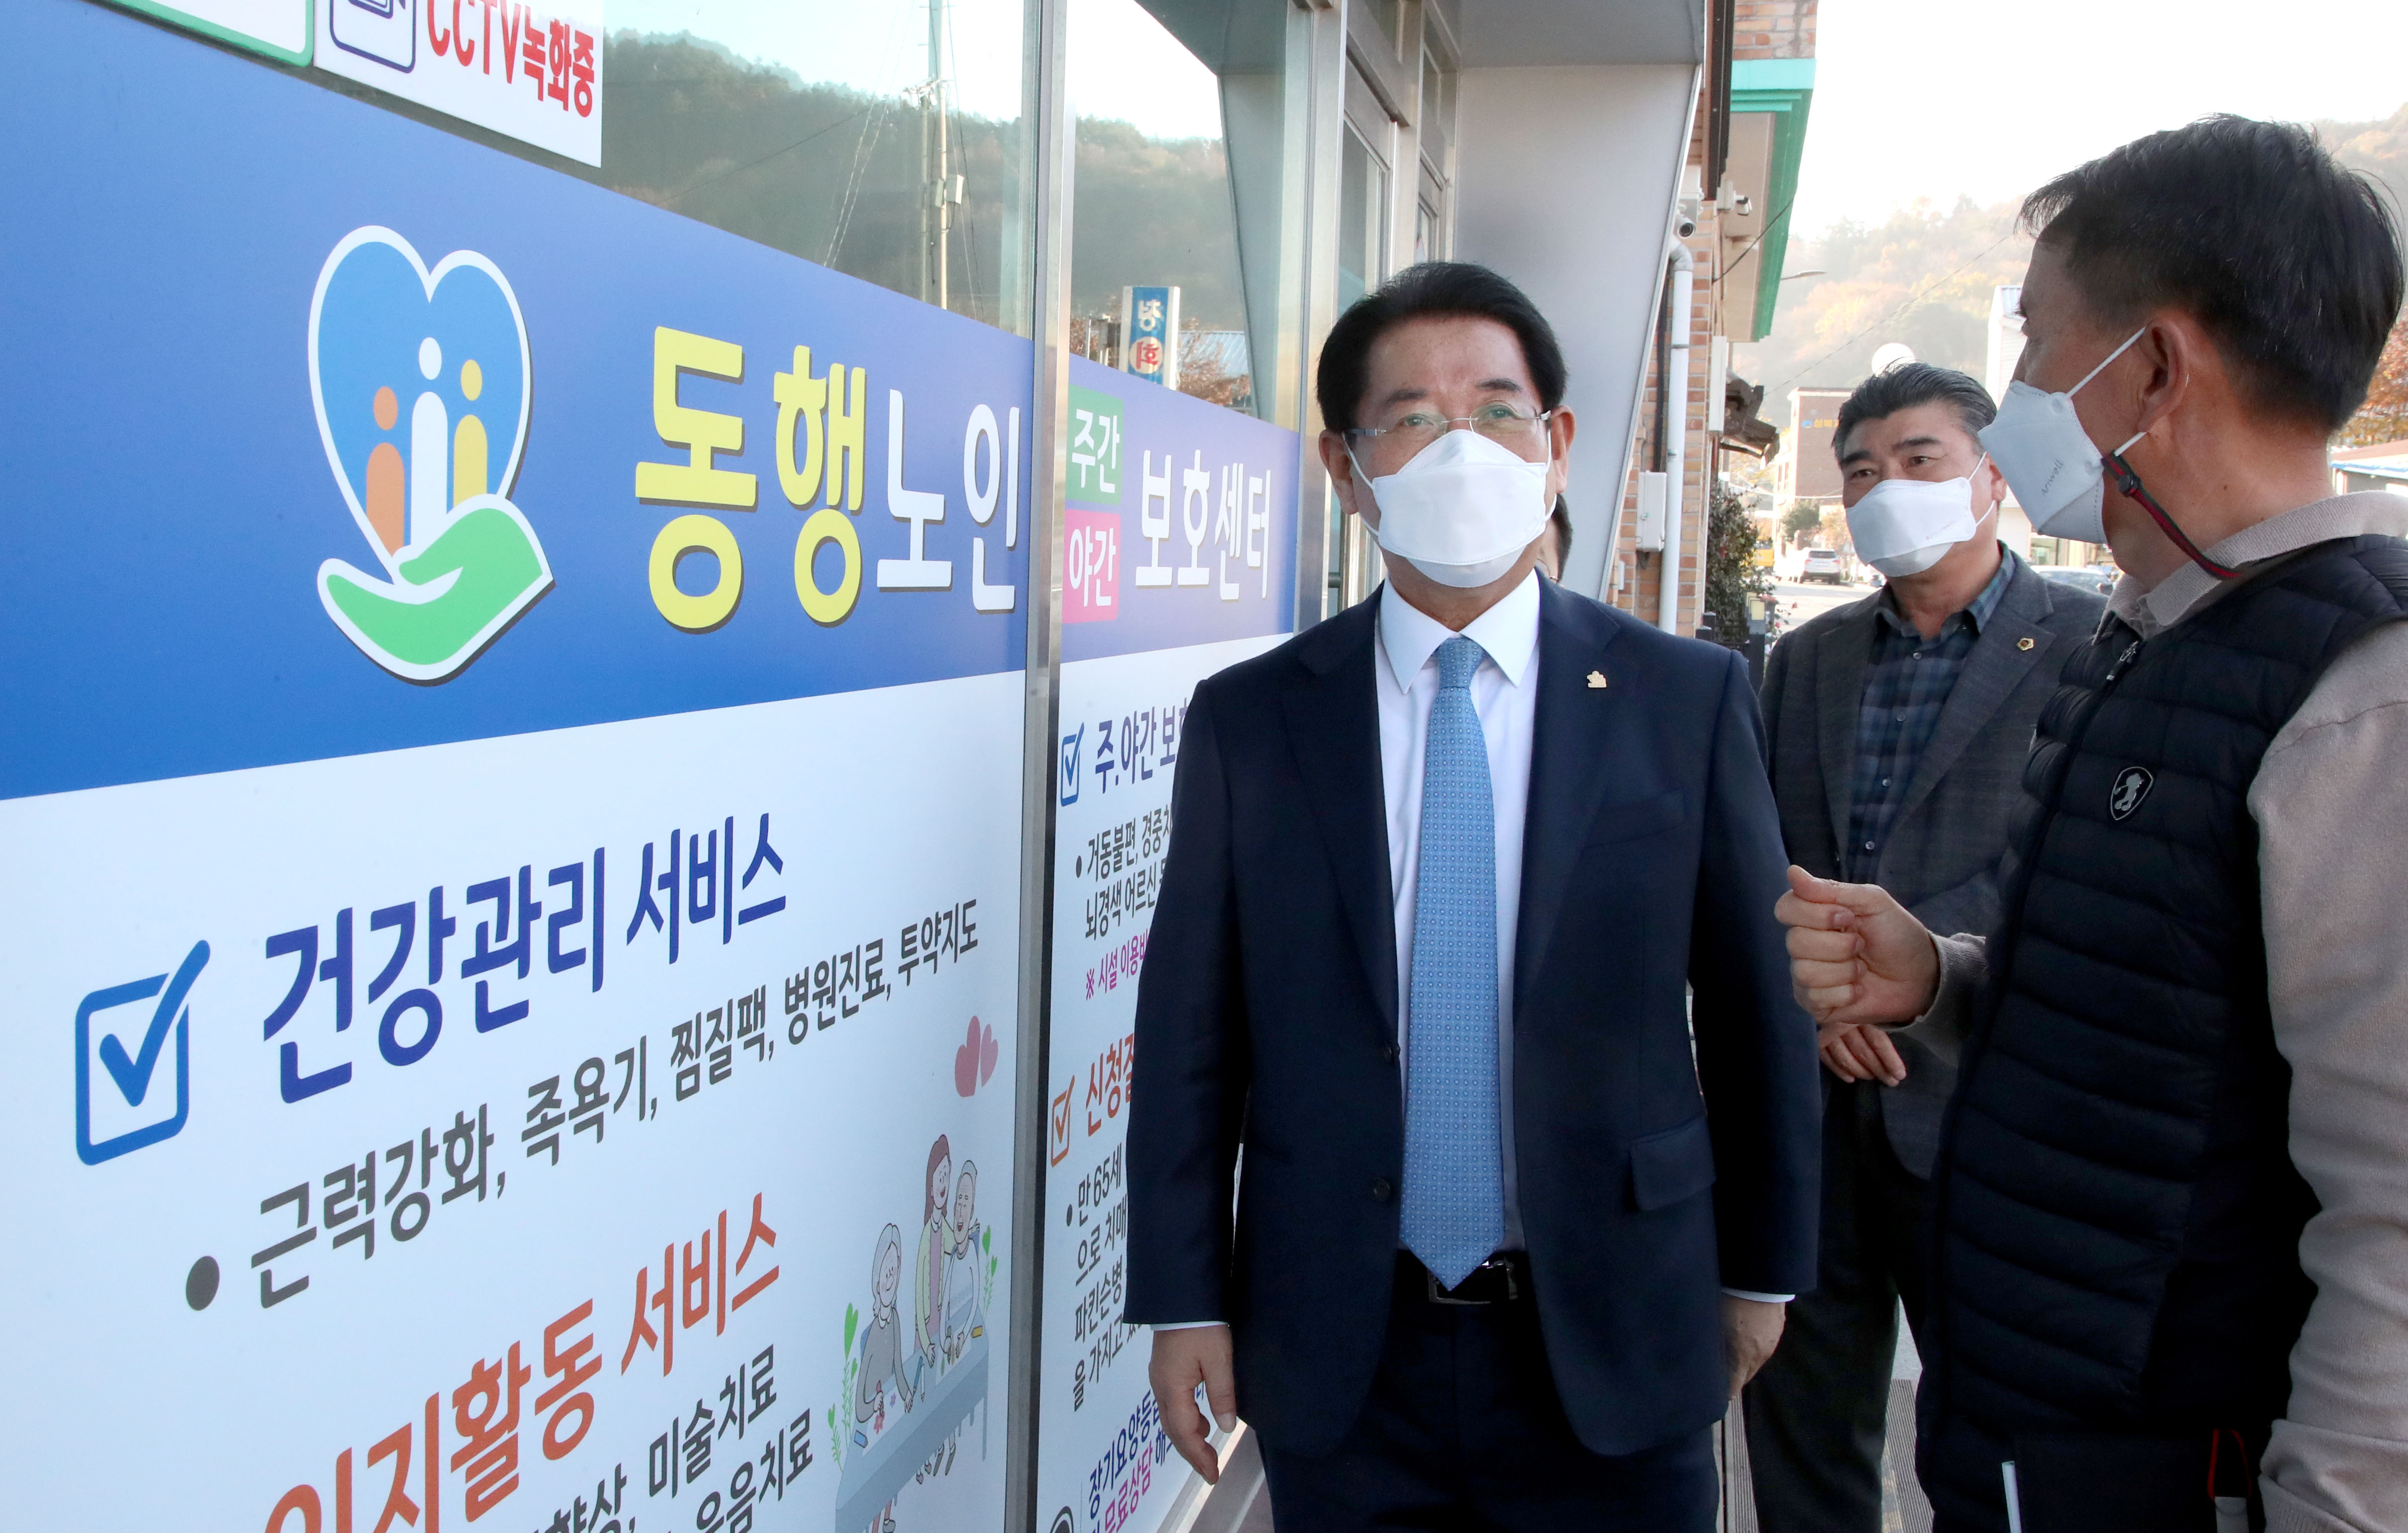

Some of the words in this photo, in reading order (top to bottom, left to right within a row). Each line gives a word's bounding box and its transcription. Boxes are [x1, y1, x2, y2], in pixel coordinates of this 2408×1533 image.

[427, 0, 594, 118] CCTV녹화중
[635, 326, 1020, 629] 동행노인
[1072, 408, 1121, 493] 주간
[1069, 526, 1116, 607] 야간
[1135, 449, 1271, 601] 보호센터
[1095, 706, 1157, 794] 주.야간
[1087, 817, 1138, 882] 거동불편,
[1085, 879, 1122, 941] 뇌경색
[1125, 861, 1157, 918] 어르신
[263, 846, 606, 1104] 건강관리
[627, 813, 787, 965] 서비스
[1098, 947, 1118, 994] 시설
[251, 1104, 505, 1310] 근력강화,
[521, 1037, 658, 1167] 족욕기,
[670, 983, 775, 1102] 찜질팩,
[783, 937, 892, 1048] 병원진료,
[897, 898, 979, 987] 투약지도
[1078, 1173, 1091, 1227] 만
[1093, 1142, 1122, 1208] 65세
[621, 1191, 779, 1378] 서비스
[1075, 1254, 1123, 1343] 파킨슨병
[1076, 1224, 1101, 1287] 으로
[1073, 1359, 1085, 1412] 을
[1089, 1312, 1124, 1384] 가지고
[649, 1343, 777, 1499] 미술치료
